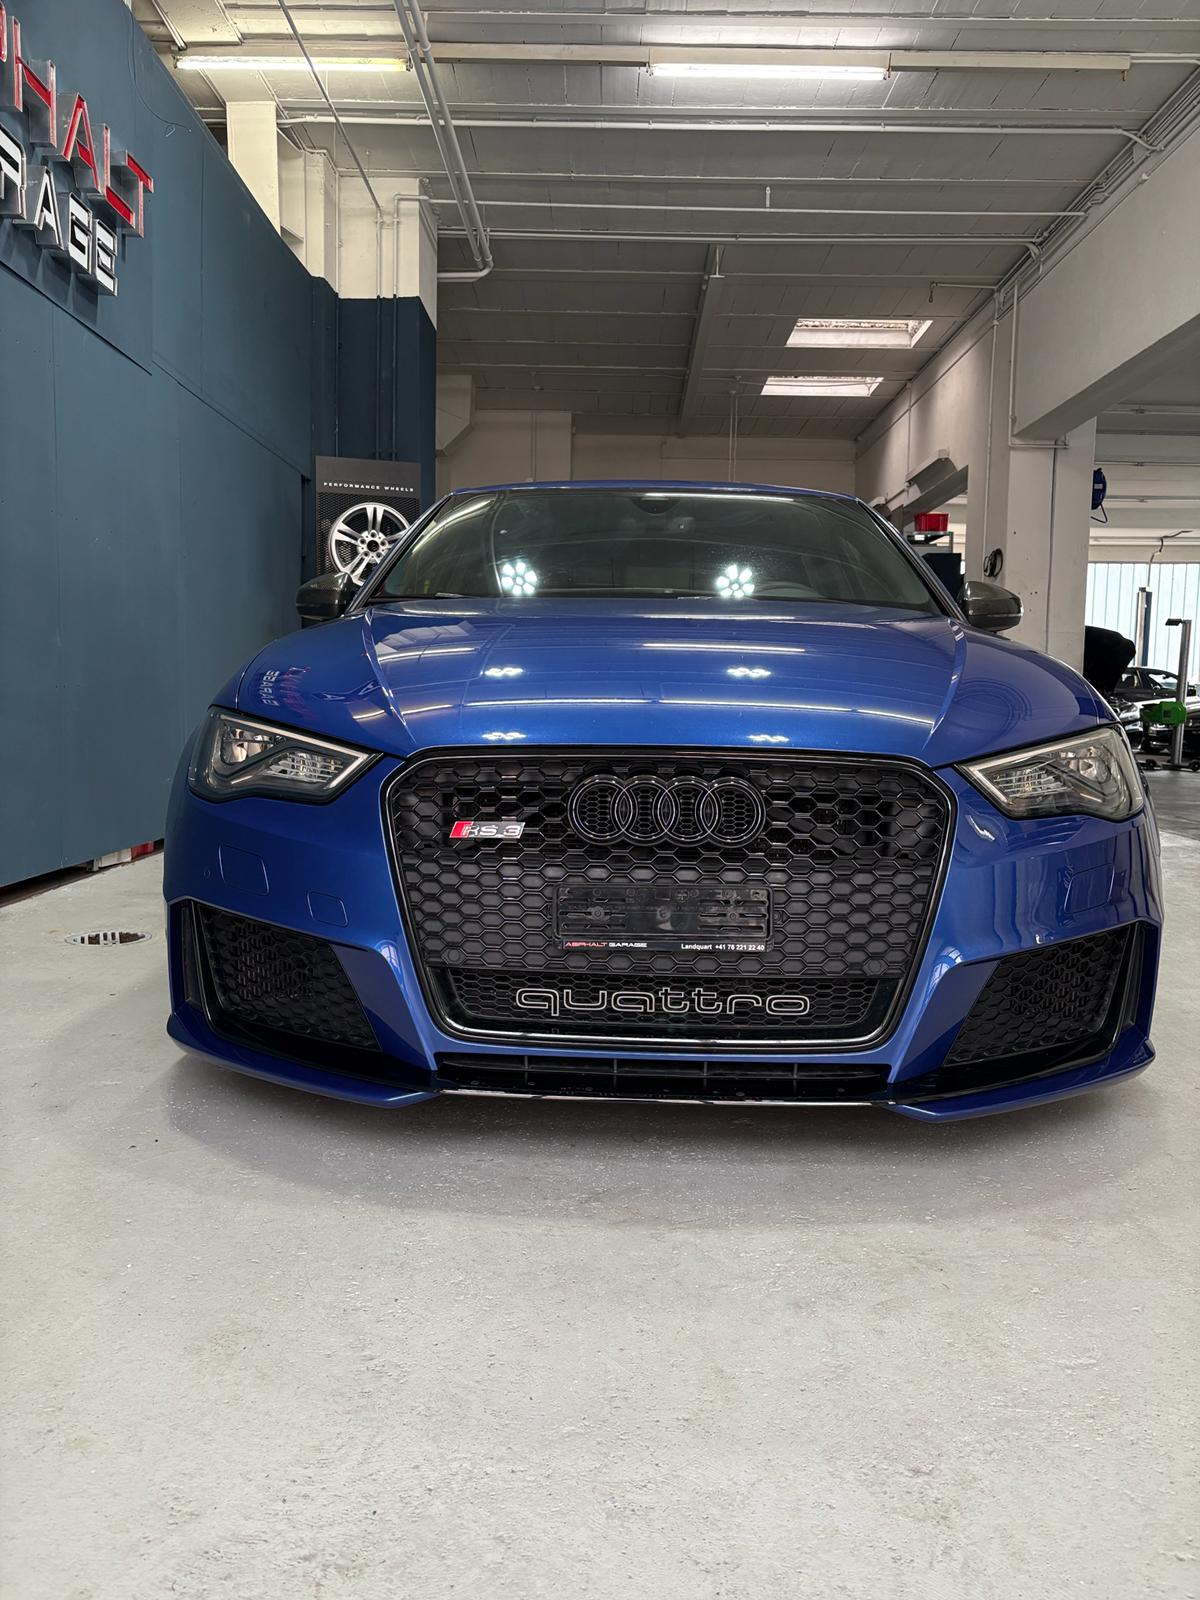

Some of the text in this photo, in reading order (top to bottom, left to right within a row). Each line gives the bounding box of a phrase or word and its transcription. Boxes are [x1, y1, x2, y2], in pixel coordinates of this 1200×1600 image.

[0, 4, 154, 238] HALT
[323, 482, 380, 490] PERFORMANCE
[515, 987, 811, 1017] quattro
